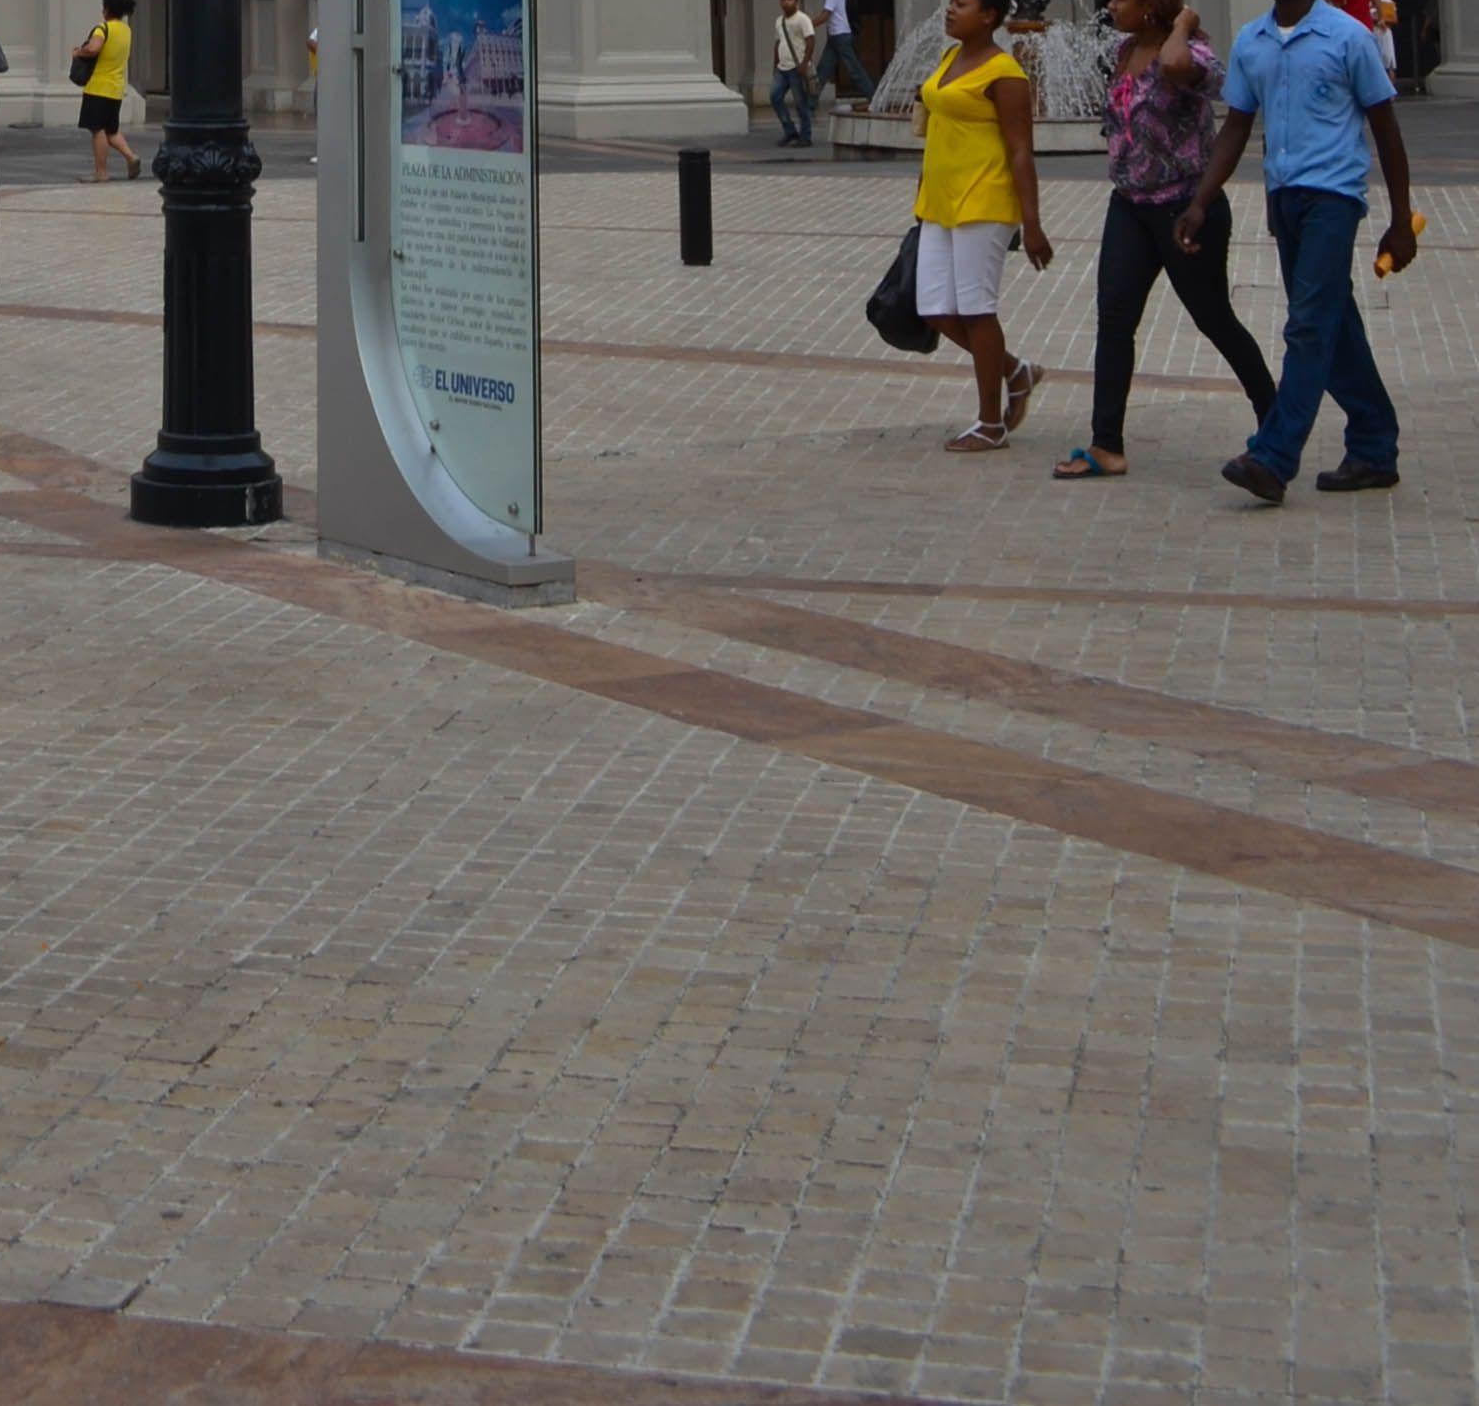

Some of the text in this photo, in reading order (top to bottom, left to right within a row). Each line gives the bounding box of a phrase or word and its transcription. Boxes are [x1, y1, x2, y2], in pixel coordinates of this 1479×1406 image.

[401, 161, 525, 185] PLAZA DE LA ADMINISTRACIÓN
[434, 369, 448, 392] EL
[450, 372, 515, 404] UNIVERSO
